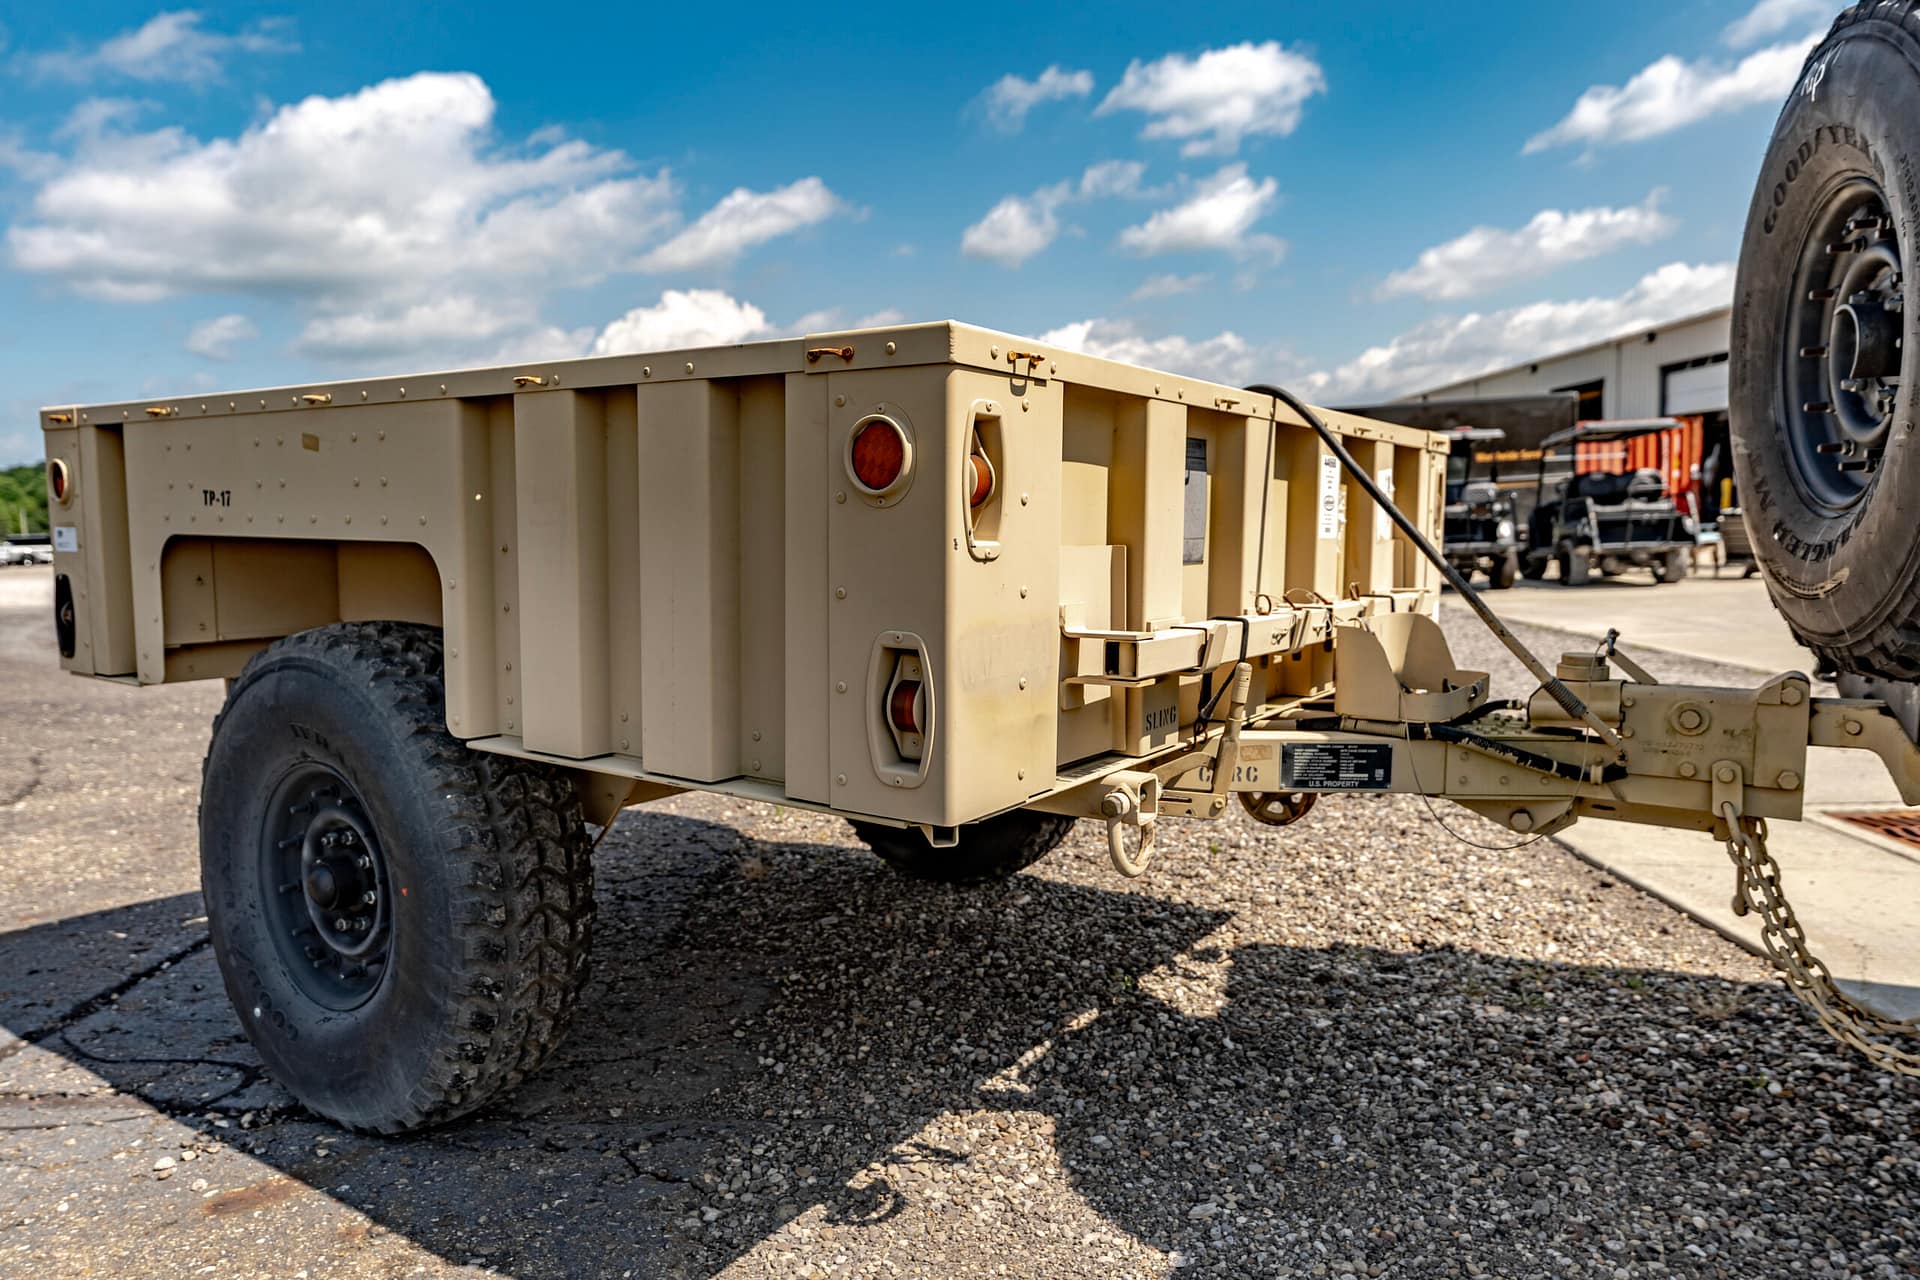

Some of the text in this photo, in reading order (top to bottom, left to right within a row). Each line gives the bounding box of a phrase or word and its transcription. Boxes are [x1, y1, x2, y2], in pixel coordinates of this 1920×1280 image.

[1764, 125, 1886, 234] GOODYEAR
[202, 489, 231, 507] TP-17
[1145, 703, 1177, 732] SLING
[1198, 765, 1259, 783] CRC
[1308, 780, 1360, 788] U.S. PROPERTY
